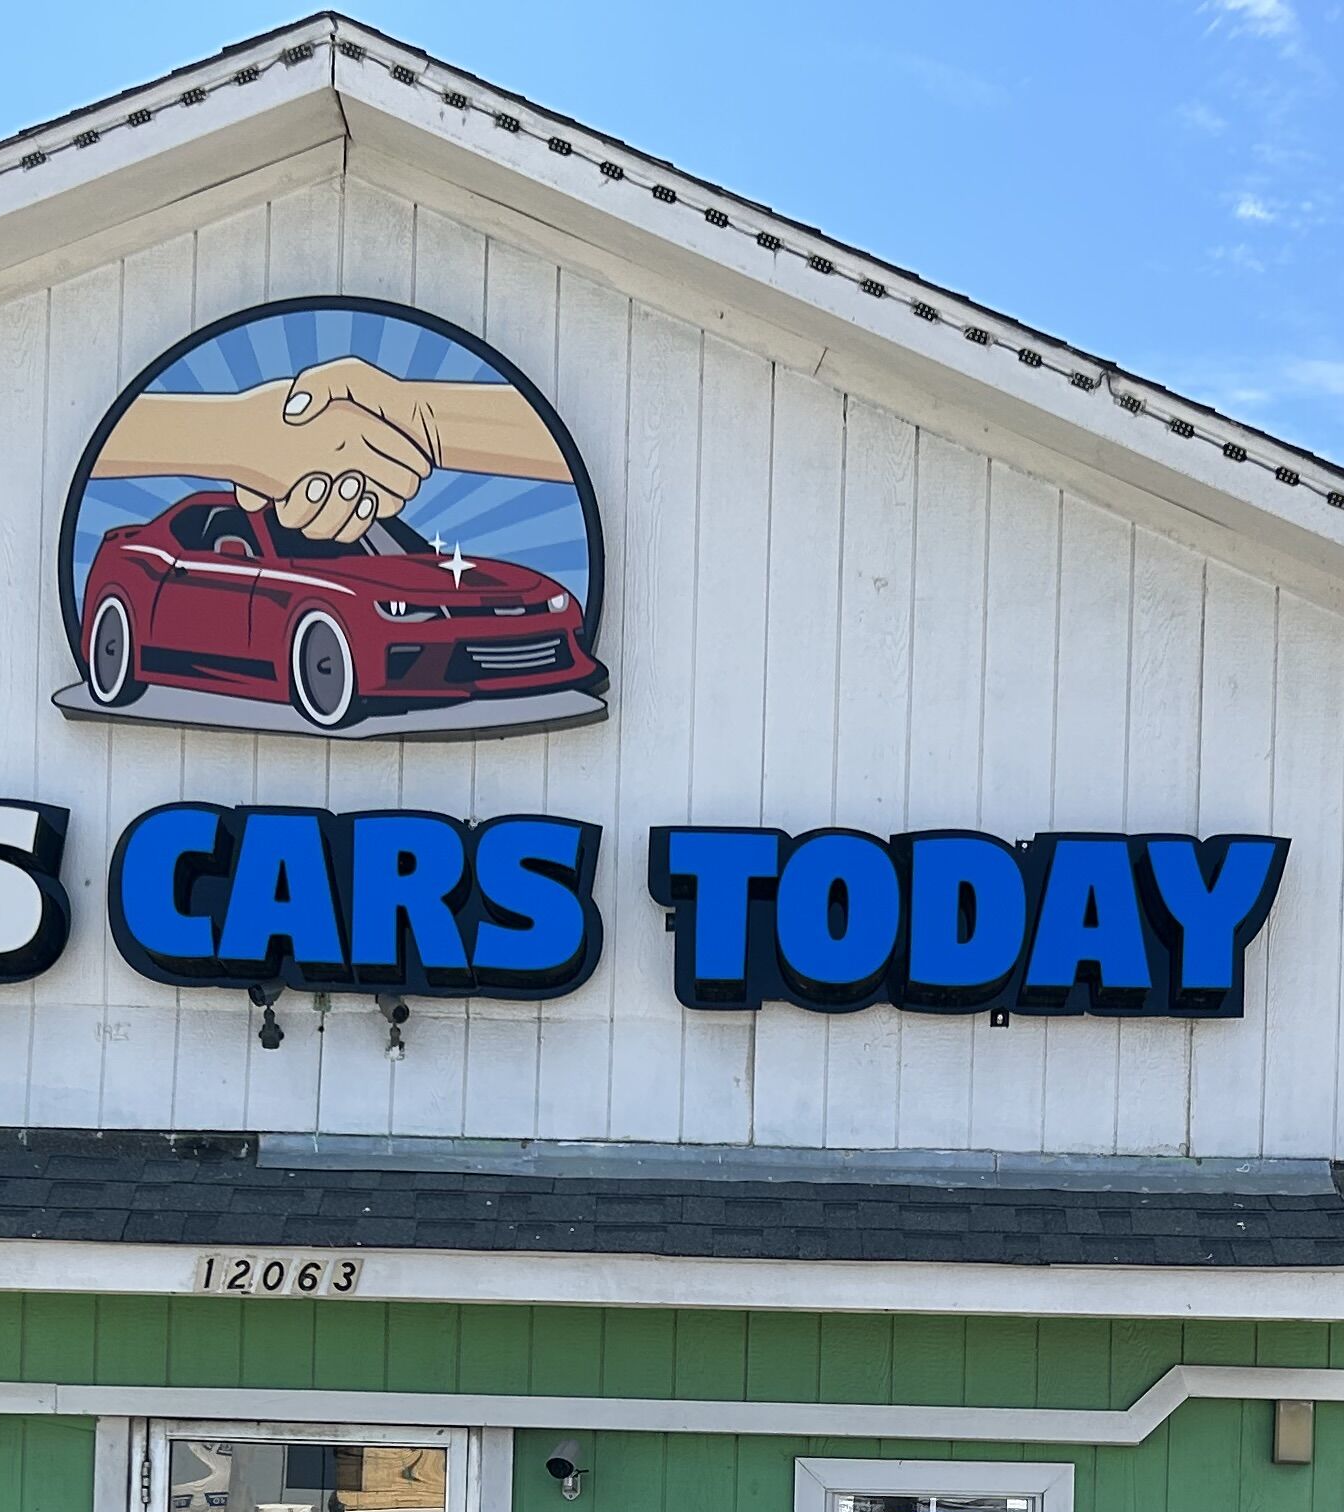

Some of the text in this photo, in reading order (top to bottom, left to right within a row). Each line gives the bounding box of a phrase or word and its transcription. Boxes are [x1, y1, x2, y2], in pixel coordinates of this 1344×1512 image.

[120, 807, 587, 972] CARS
[667, 830, 1278, 990] TODAY
[203, 1257, 357, 1292] 12063
